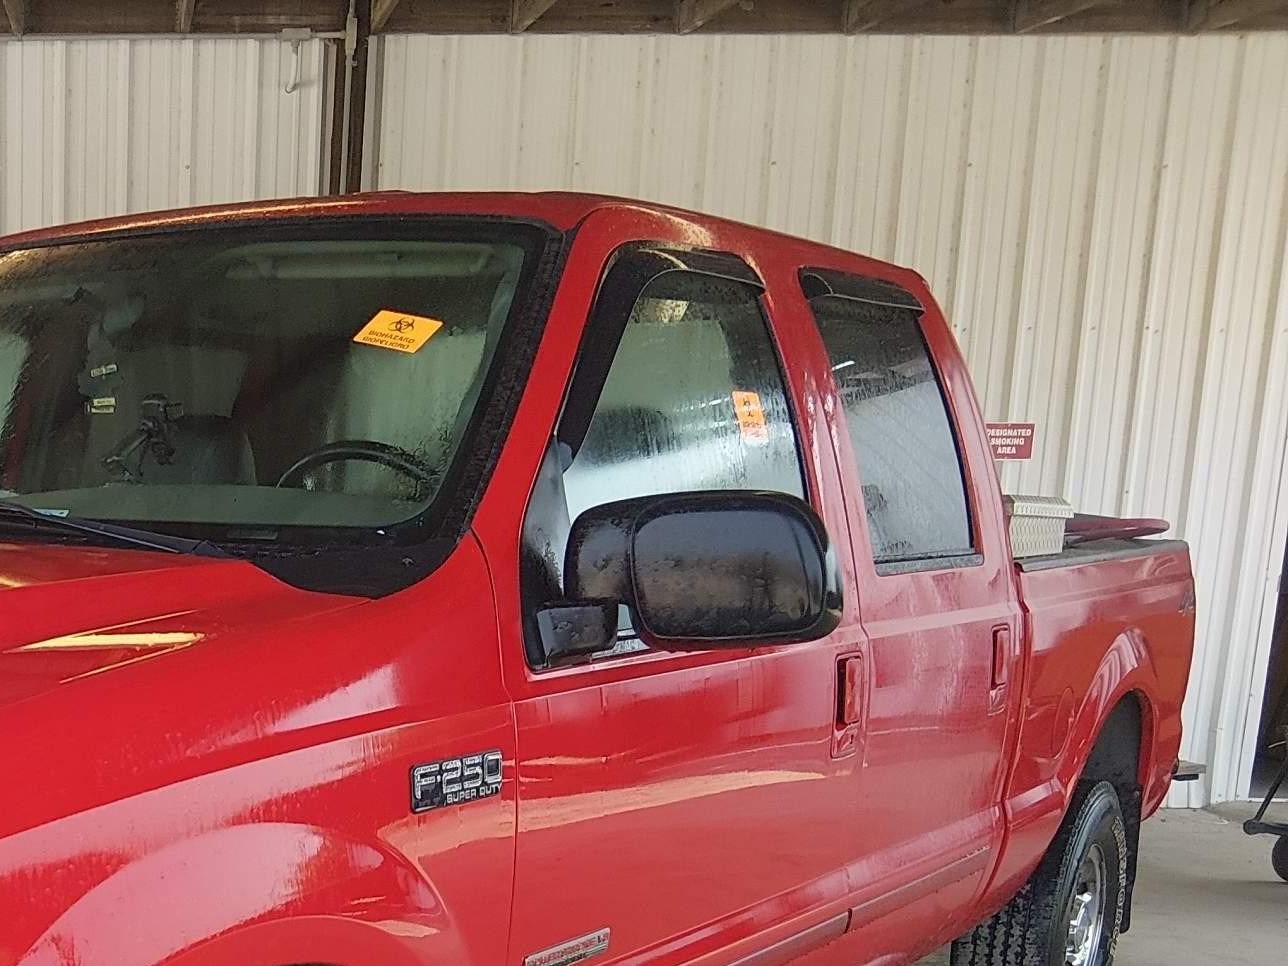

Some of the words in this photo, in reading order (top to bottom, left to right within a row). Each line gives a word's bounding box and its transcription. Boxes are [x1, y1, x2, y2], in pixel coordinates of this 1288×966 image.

[991, 438, 1025, 446] SMOKING
[997, 446, 1016, 454] AREA
[446, 788, 477, 804] SUPER
[479, 783, 503, 797] DUTY
